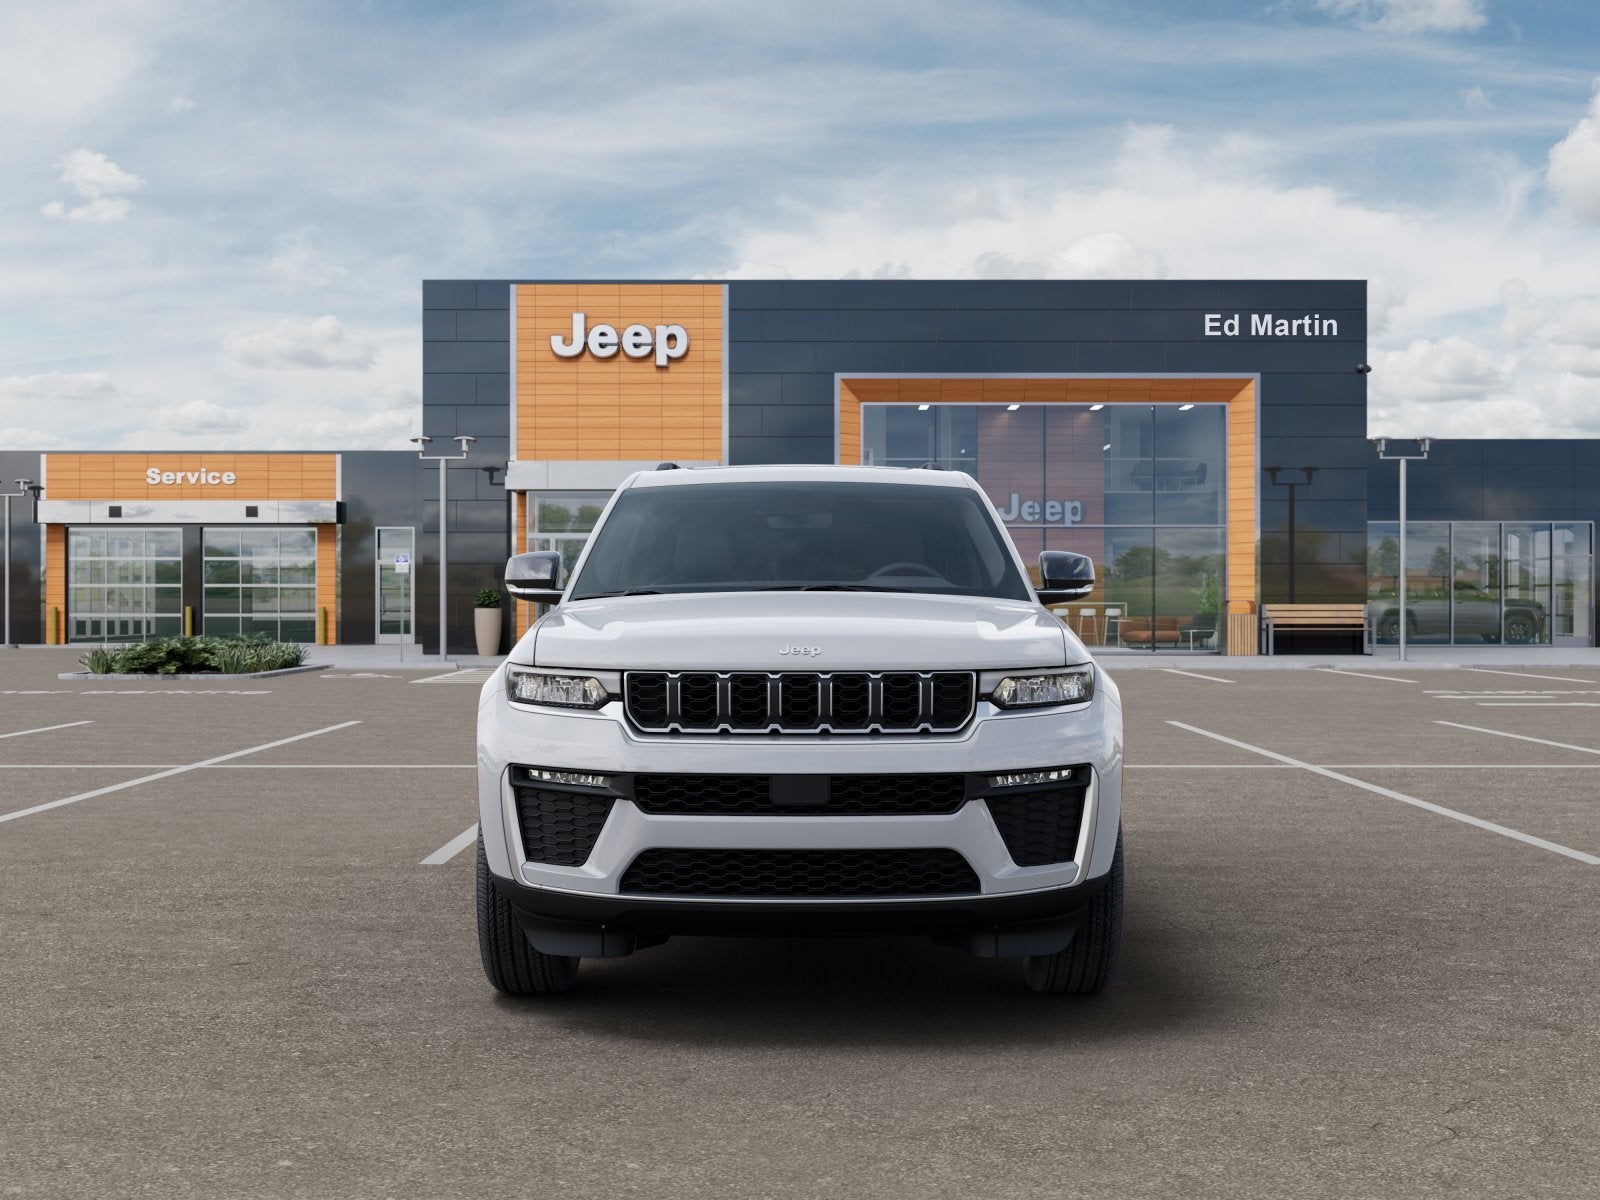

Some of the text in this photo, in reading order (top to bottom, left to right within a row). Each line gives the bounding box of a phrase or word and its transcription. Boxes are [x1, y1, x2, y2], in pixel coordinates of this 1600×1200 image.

[1204, 313, 1338, 336] Ed Martin
[550, 312, 689, 367] Jeep
[146, 467, 236, 485] Service
[997, 493, 1083, 526] Jeep
[778, 642, 821, 657] Jeep
